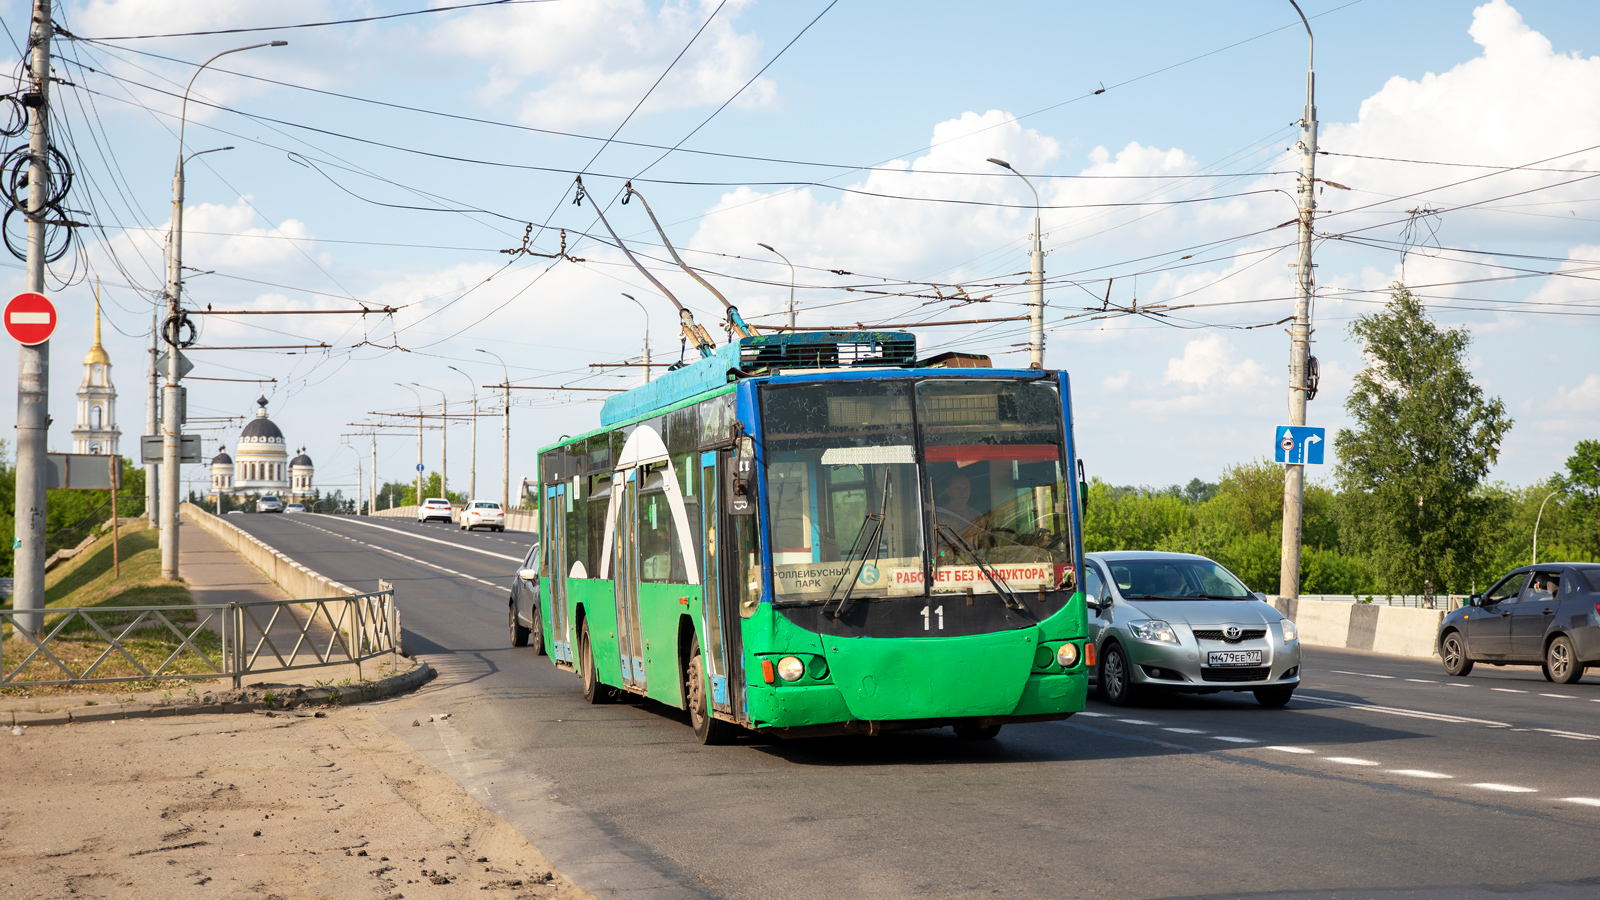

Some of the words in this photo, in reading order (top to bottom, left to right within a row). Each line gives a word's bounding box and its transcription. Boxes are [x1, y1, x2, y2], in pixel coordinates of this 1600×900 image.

[773, 567, 851, 580] РОЛЛЕЙБУСНЫЙ
[862, 565, 875, 583] 6
[896, 570, 951, 584] РАБОАЕТ
[954, 570, 974, 582] БЕЗ
[977, 568, 1045, 583] КОНДУКТОРА
[795, 579, 821, 588] ПАРК
[920, 605, 944, 631] 11
